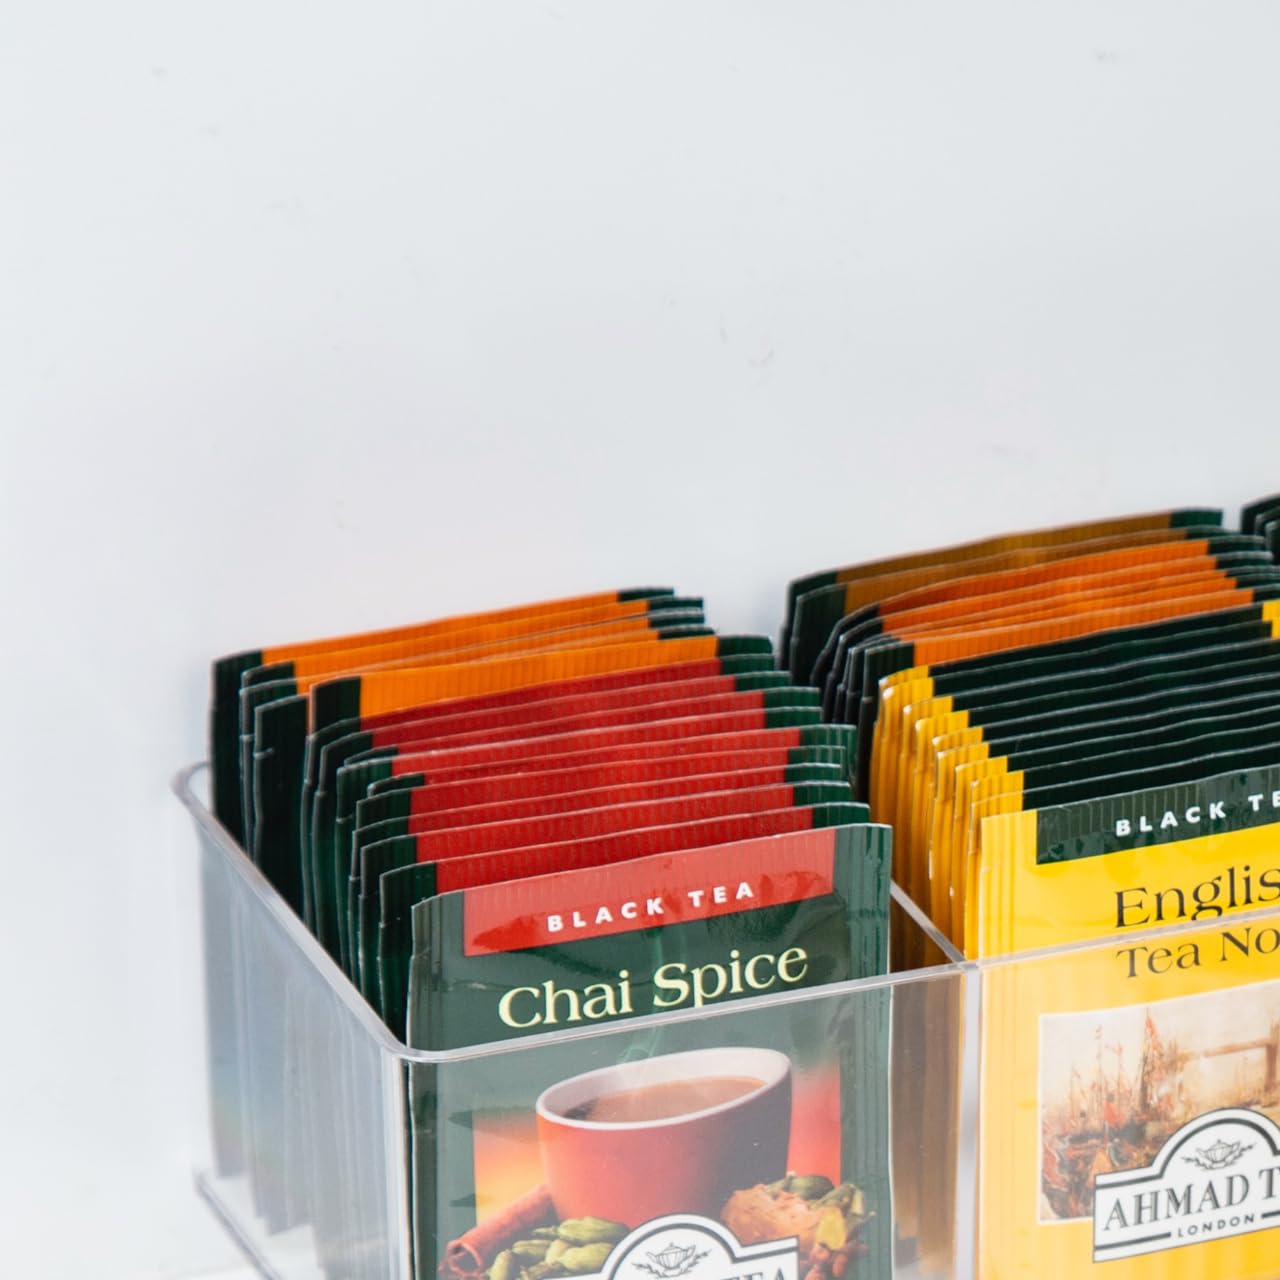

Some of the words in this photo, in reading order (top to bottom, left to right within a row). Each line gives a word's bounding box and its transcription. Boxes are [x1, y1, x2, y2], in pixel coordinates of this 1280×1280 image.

[1115, 801, 1226, 838] BLACK
[546, 896, 664, 933] BLACK
[688, 881, 754, 908] TEA
[1115, 943, 1201, 978] Tea
[498, 969, 634, 1028] Chai
[653, 946, 808, 1008] Spice
[1103, 1173, 1250, 1232] AHMAD
[1177, 1213, 1255, 1238] LONDON
